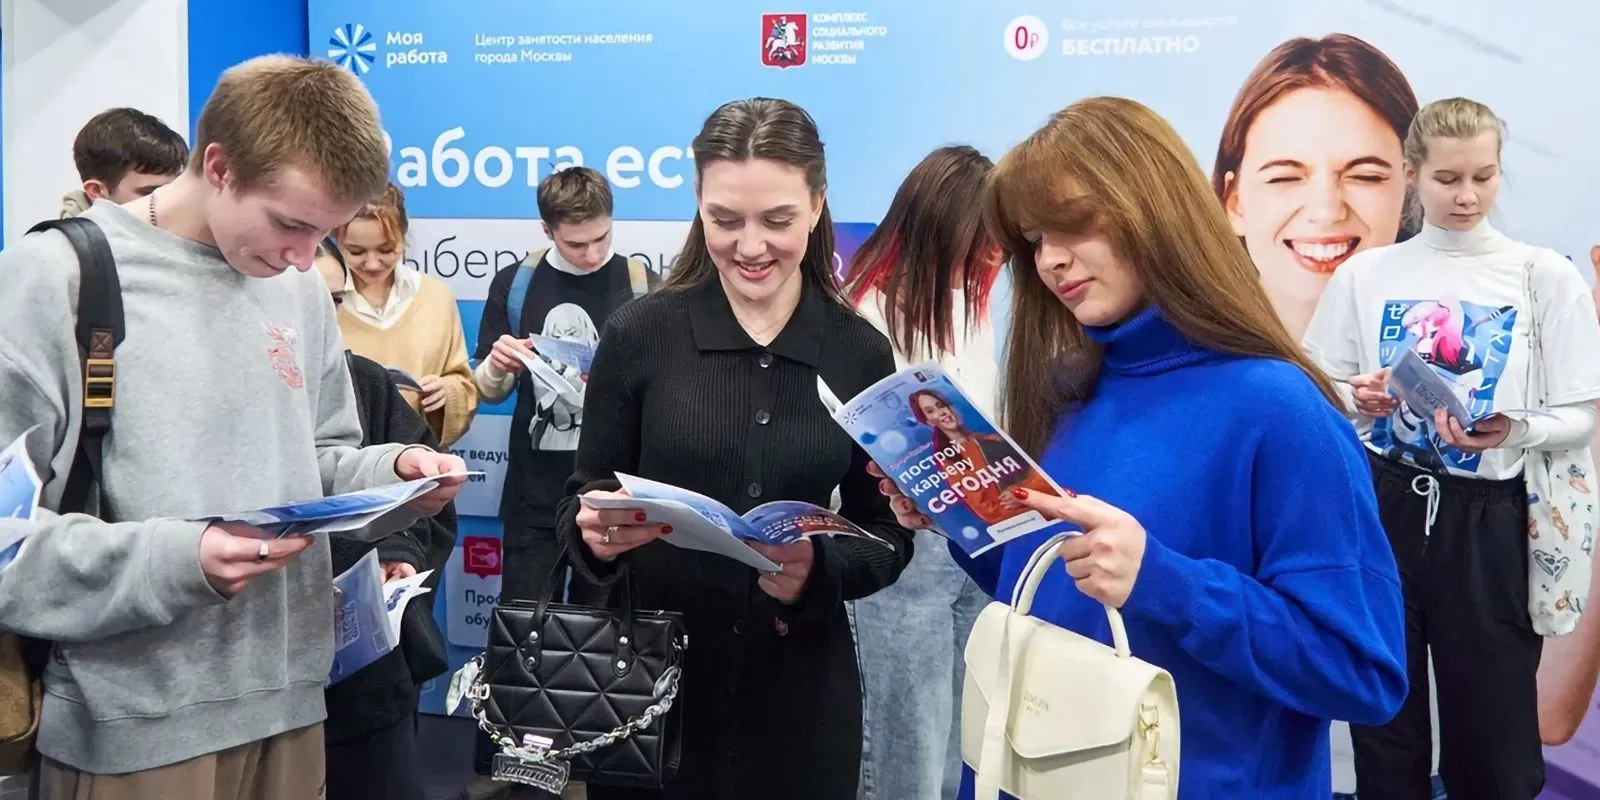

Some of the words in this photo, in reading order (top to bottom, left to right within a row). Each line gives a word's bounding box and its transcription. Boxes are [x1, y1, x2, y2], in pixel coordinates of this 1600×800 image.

[386, 31, 424, 46] Моя
[475, 32, 516, 48] Центр
[518, 33, 582, 46] занятости
[584, 32, 653, 45] населения
[1061, 35, 1200, 56] БЕСПЛАТНО
[386, 48, 448, 68] работа
[475, 51, 518, 65] города
[520, 49, 572, 62] Москвы
[381, 126, 584, 188] абота
[898, 439, 966, 484] построй
[910, 456, 975, 497] карьеру
[927, 455, 1022, 514] сегодня
